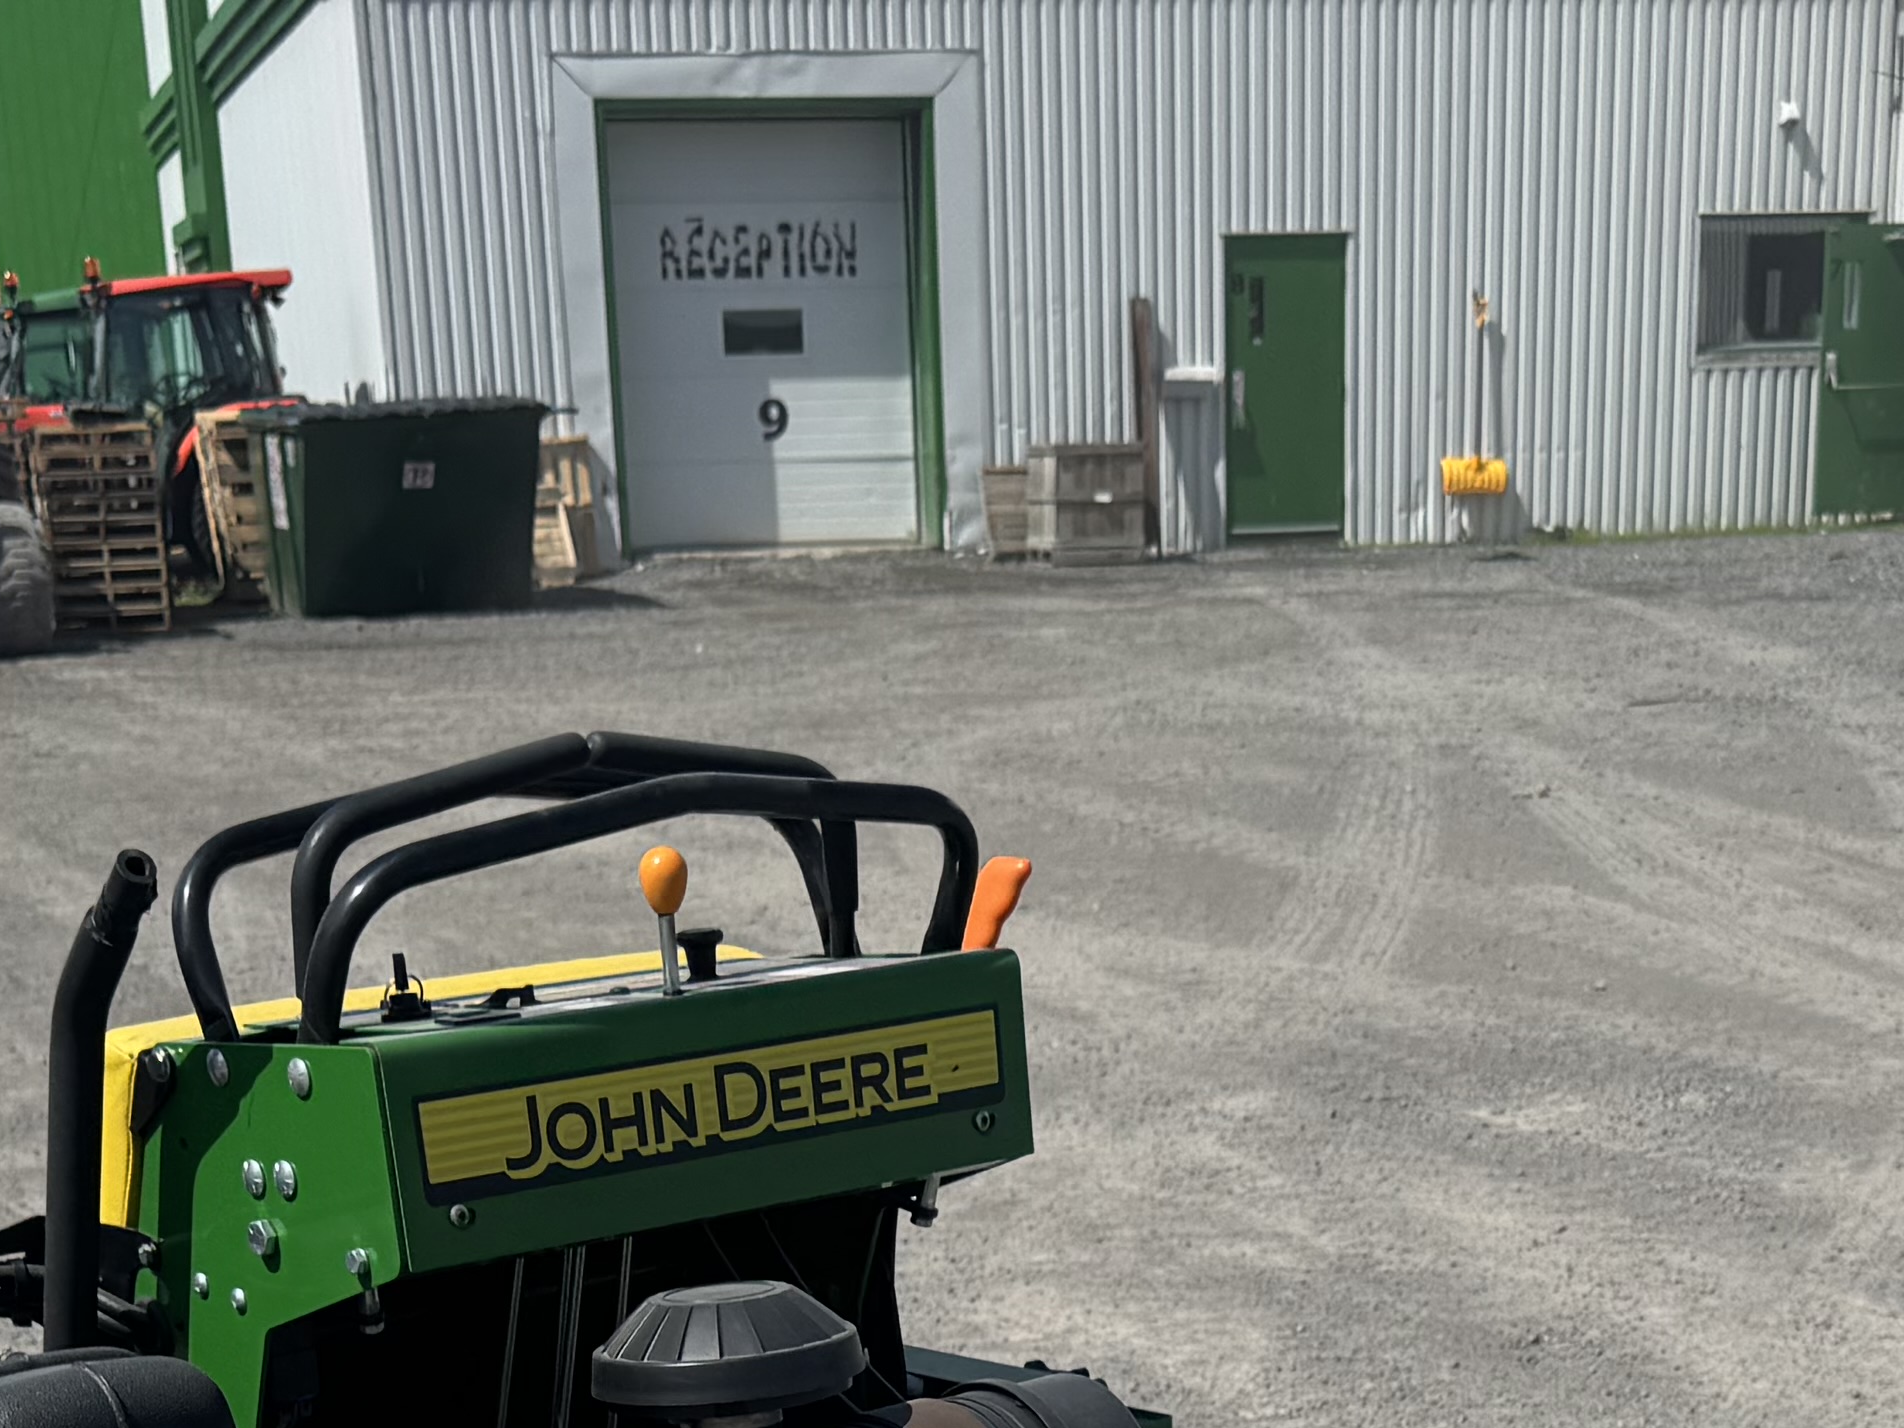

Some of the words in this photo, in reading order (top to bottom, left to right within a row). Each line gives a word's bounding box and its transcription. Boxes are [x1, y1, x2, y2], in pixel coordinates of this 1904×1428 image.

[758, 399, 790, 442] 9
[504, 1081, 702, 1174] JOHN
[712, 1042, 938, 1136] DEERE
